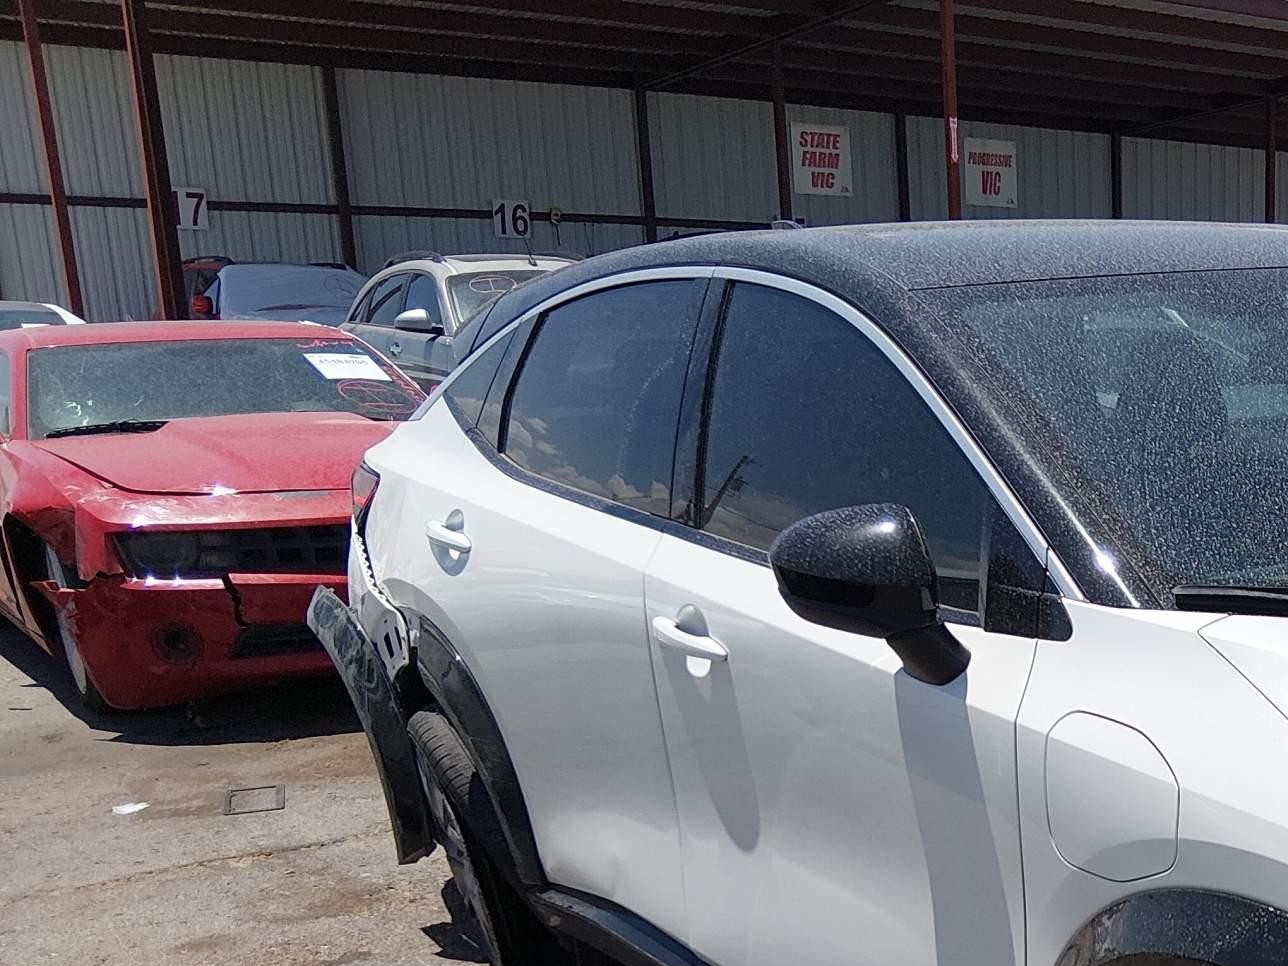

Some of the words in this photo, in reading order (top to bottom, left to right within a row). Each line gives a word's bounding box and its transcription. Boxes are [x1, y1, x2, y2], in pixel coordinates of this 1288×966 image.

[799, 131, 841, 150] STATE
[801, 151, 840, 169] FARM
[968, 151, 1013, 168] PROGRESSIVE
[811, 171, 836, 189] VIC
[981, 170, 1001, 196] VIC
[494, 203, 530, 236] 16
